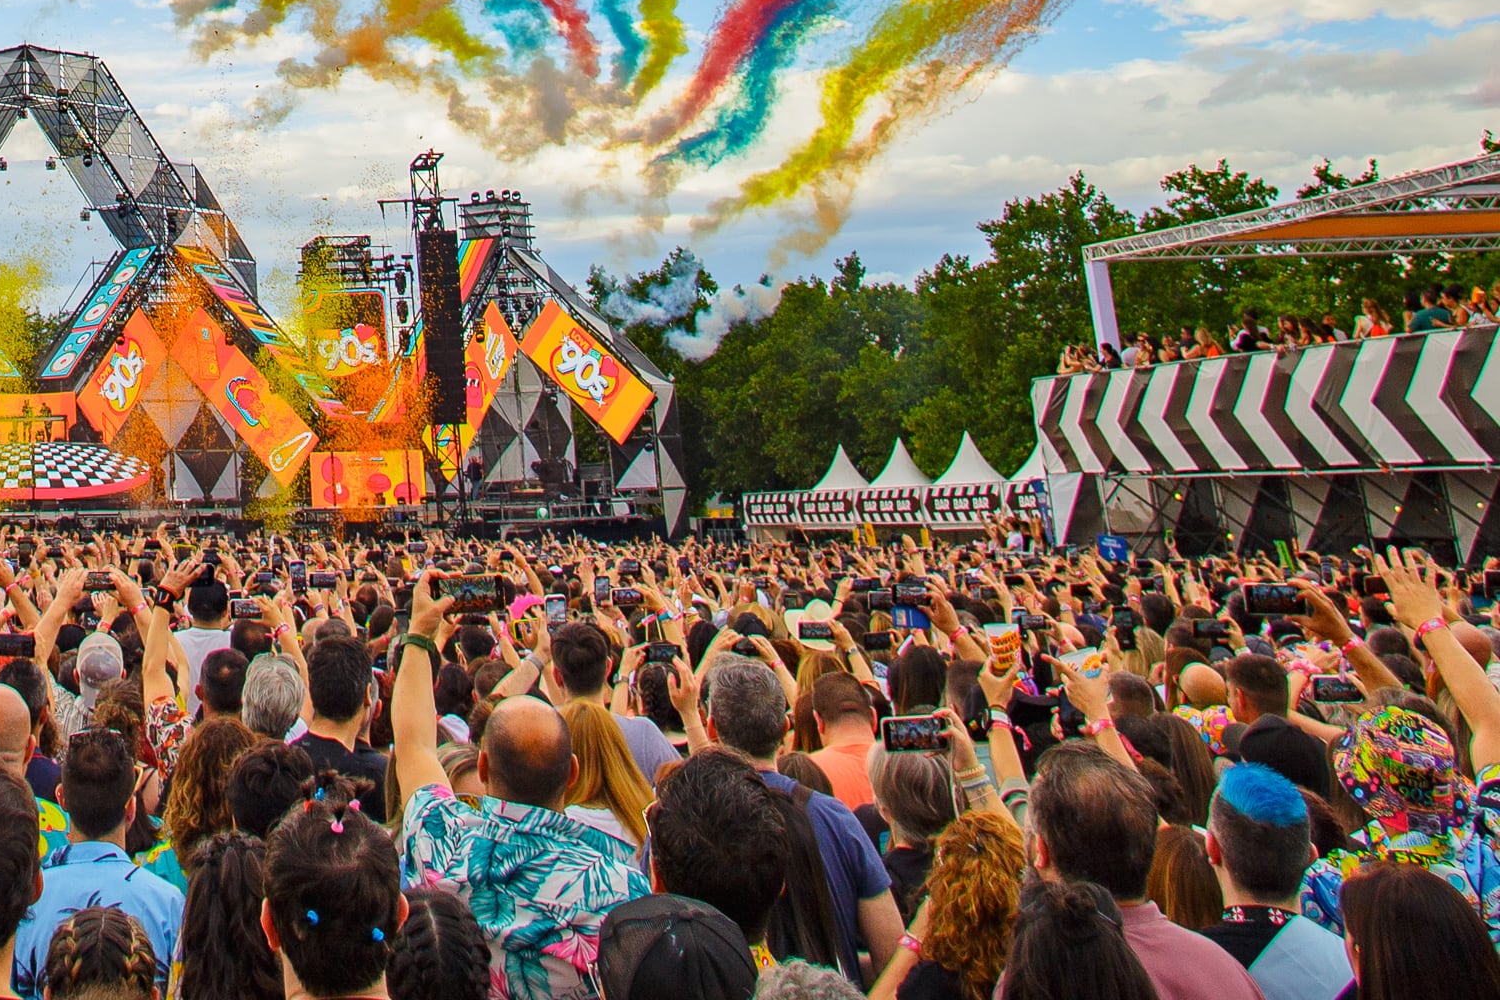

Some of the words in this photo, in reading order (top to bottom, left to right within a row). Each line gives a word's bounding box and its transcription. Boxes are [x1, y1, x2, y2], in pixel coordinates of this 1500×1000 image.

[317, 335, 377, 370] 90s
[571, 331, 590, 353] LOVE
[103, 350, 145, 409] 90s
[557, 339, 609, 402] 90s
[934, 498, 950, 510] BAR
[953, 497, 970, 510] BAR
[972, 496, 990, 509] BAR
[1018, 495, 1037, 508] BAR
